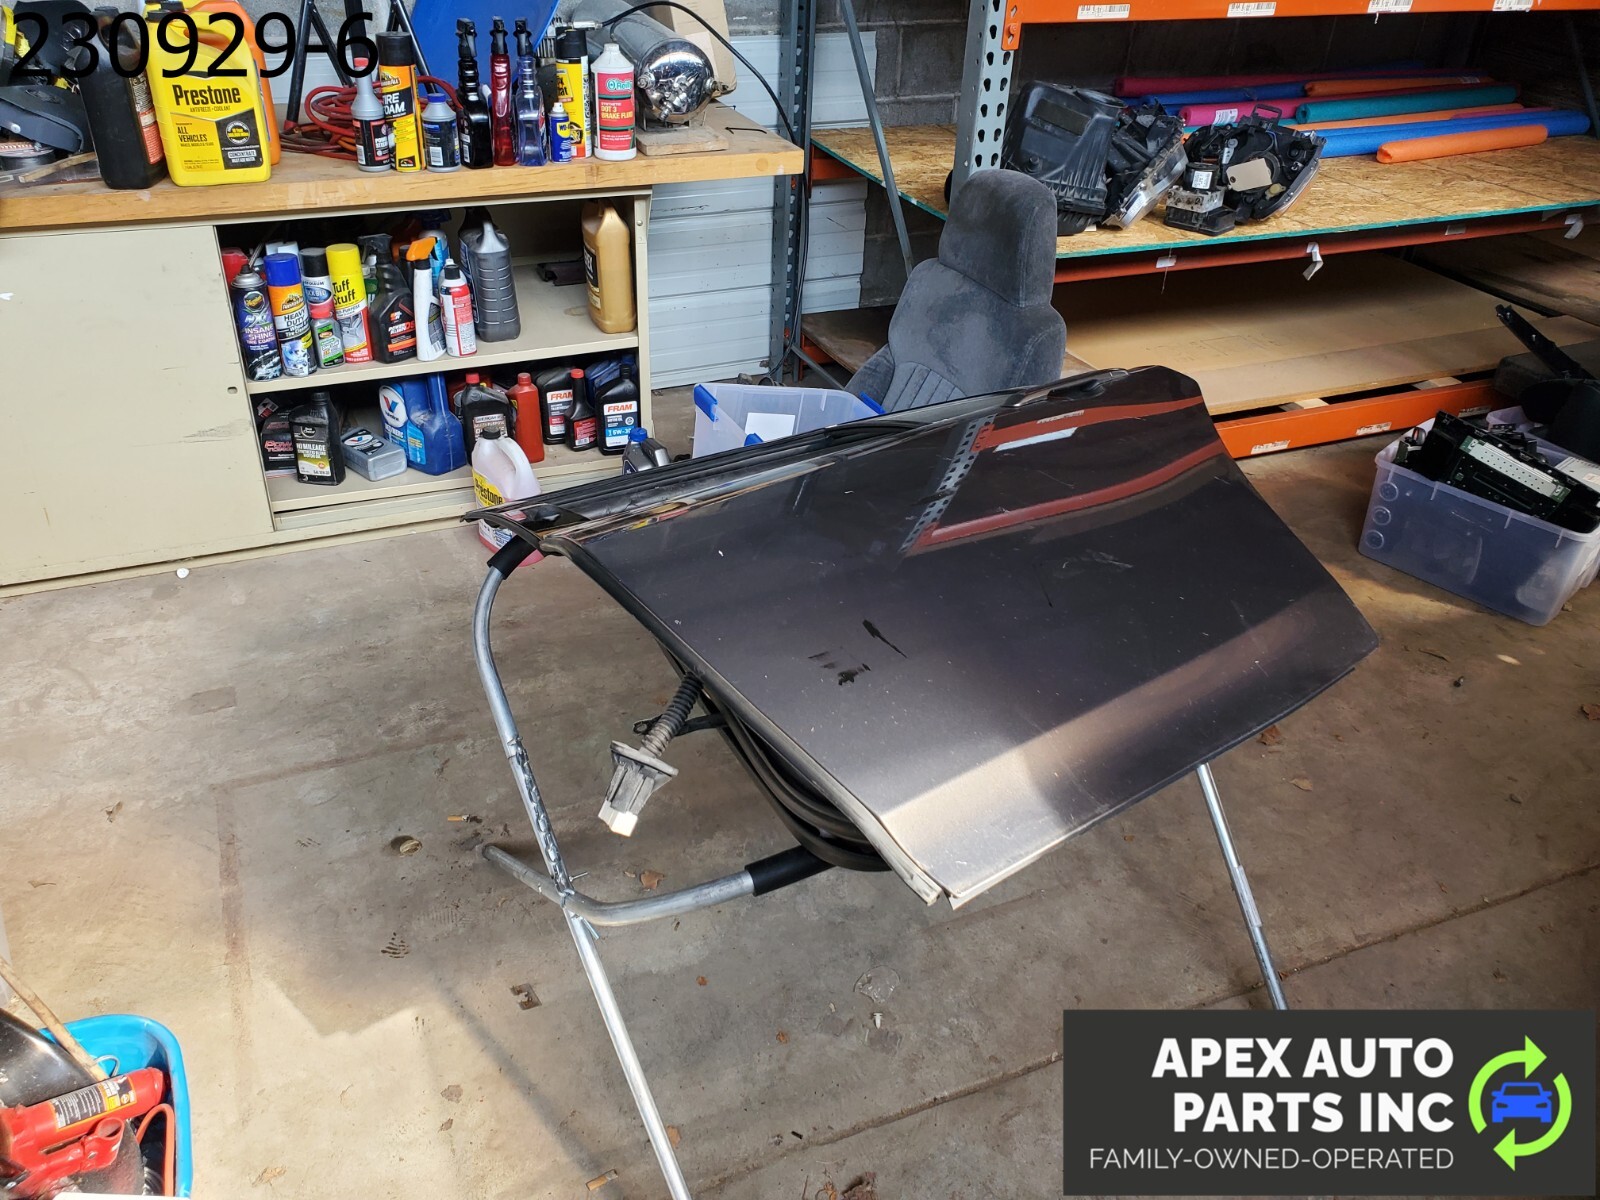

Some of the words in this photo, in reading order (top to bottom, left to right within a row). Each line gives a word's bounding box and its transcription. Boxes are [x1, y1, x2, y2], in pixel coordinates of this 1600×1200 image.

[172, 84, 242, 106] Prestone
[384, 102, 405, 115] OAM
[177, 126, 189, 135] ALL
[178, 133, 208, 143] VEHICLES
[332, 278, 350, 294] Tuff
[333, 288, 356, 306] Stuff
[284, 308, 305, 321] HEAVY
[287, 316, 305, 327] DUTY
[245, 325, 274, 334] INSANE
[248, 331, 273, 340] SHINE
[550, 391, 573, 400] FRAM
[607, 403, 633, 413] FRAM
[303, 443, 326, 452] MILEAGE
